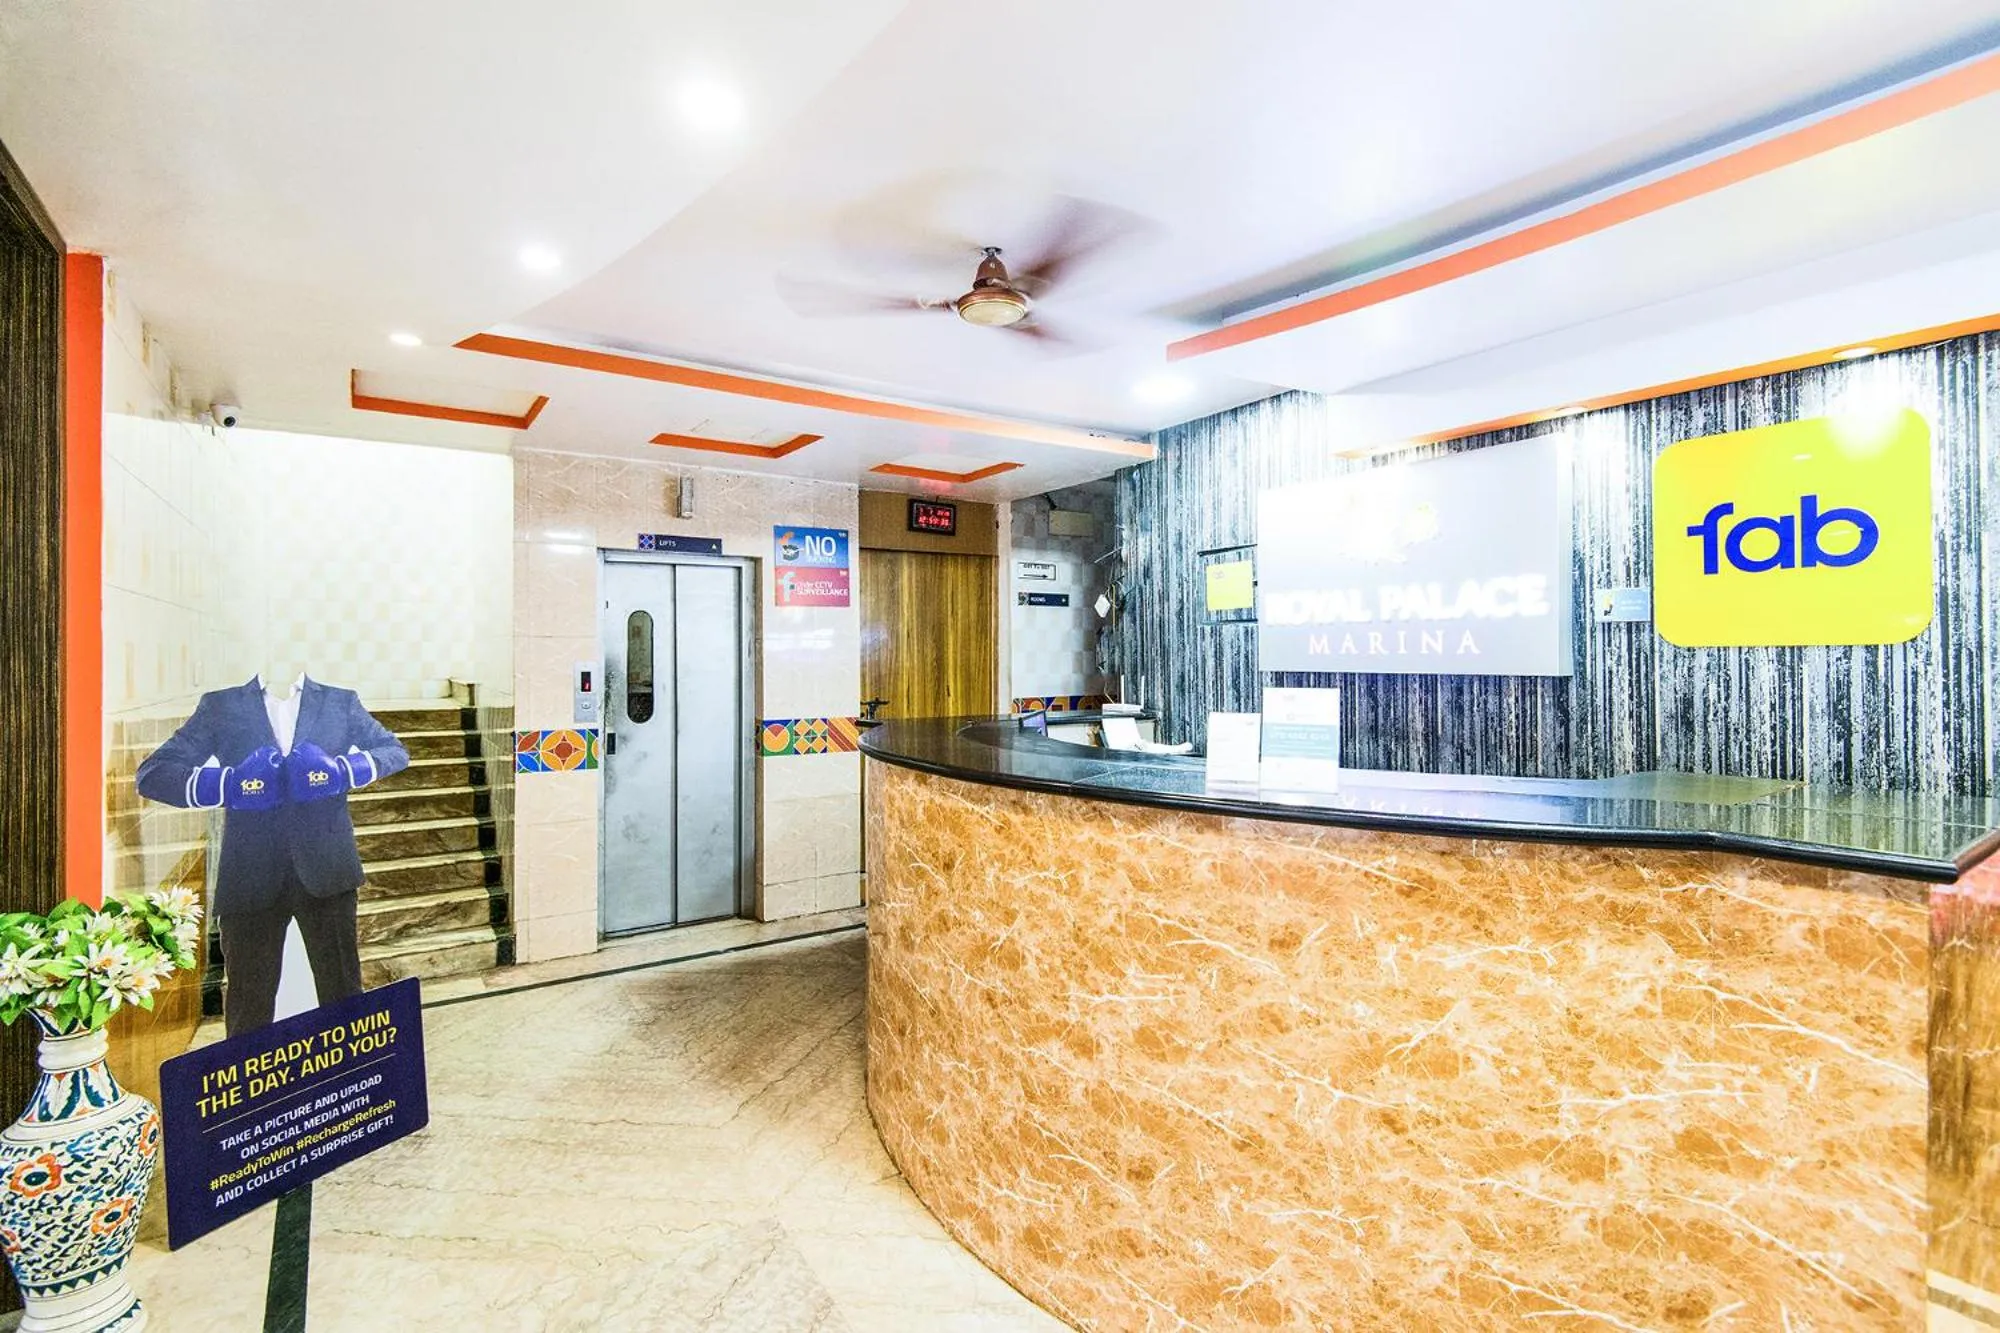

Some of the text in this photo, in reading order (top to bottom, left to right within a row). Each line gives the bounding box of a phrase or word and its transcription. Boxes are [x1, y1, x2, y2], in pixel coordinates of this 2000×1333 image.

[804, 535, 837, 557] NO
[1686, 494, 1879, 575] fab
[1378, 573, 1549, 624] PALACE
[1308, 629, 1481, 655] MARINA
[240, 778, 265, 791] fab
[306, 770, 329, 782] fab
[195, 1026, 398, 1119] THE DAY. AND YOU?
[202, 1010, 391, 1094] I'M READY TO WIN
[209, 1098, 397, 1191] #ReadyToWin #RechargeRefresh
[220, 1073, 383, 1151] TAKE A PICTURE AND UPLOAD
[240, 1094, 370, 1160] ON SOCIAL MEDIA WITH
[215, 1115, 395, 1208] AND COLLECT A SURPRISE GIFT!
